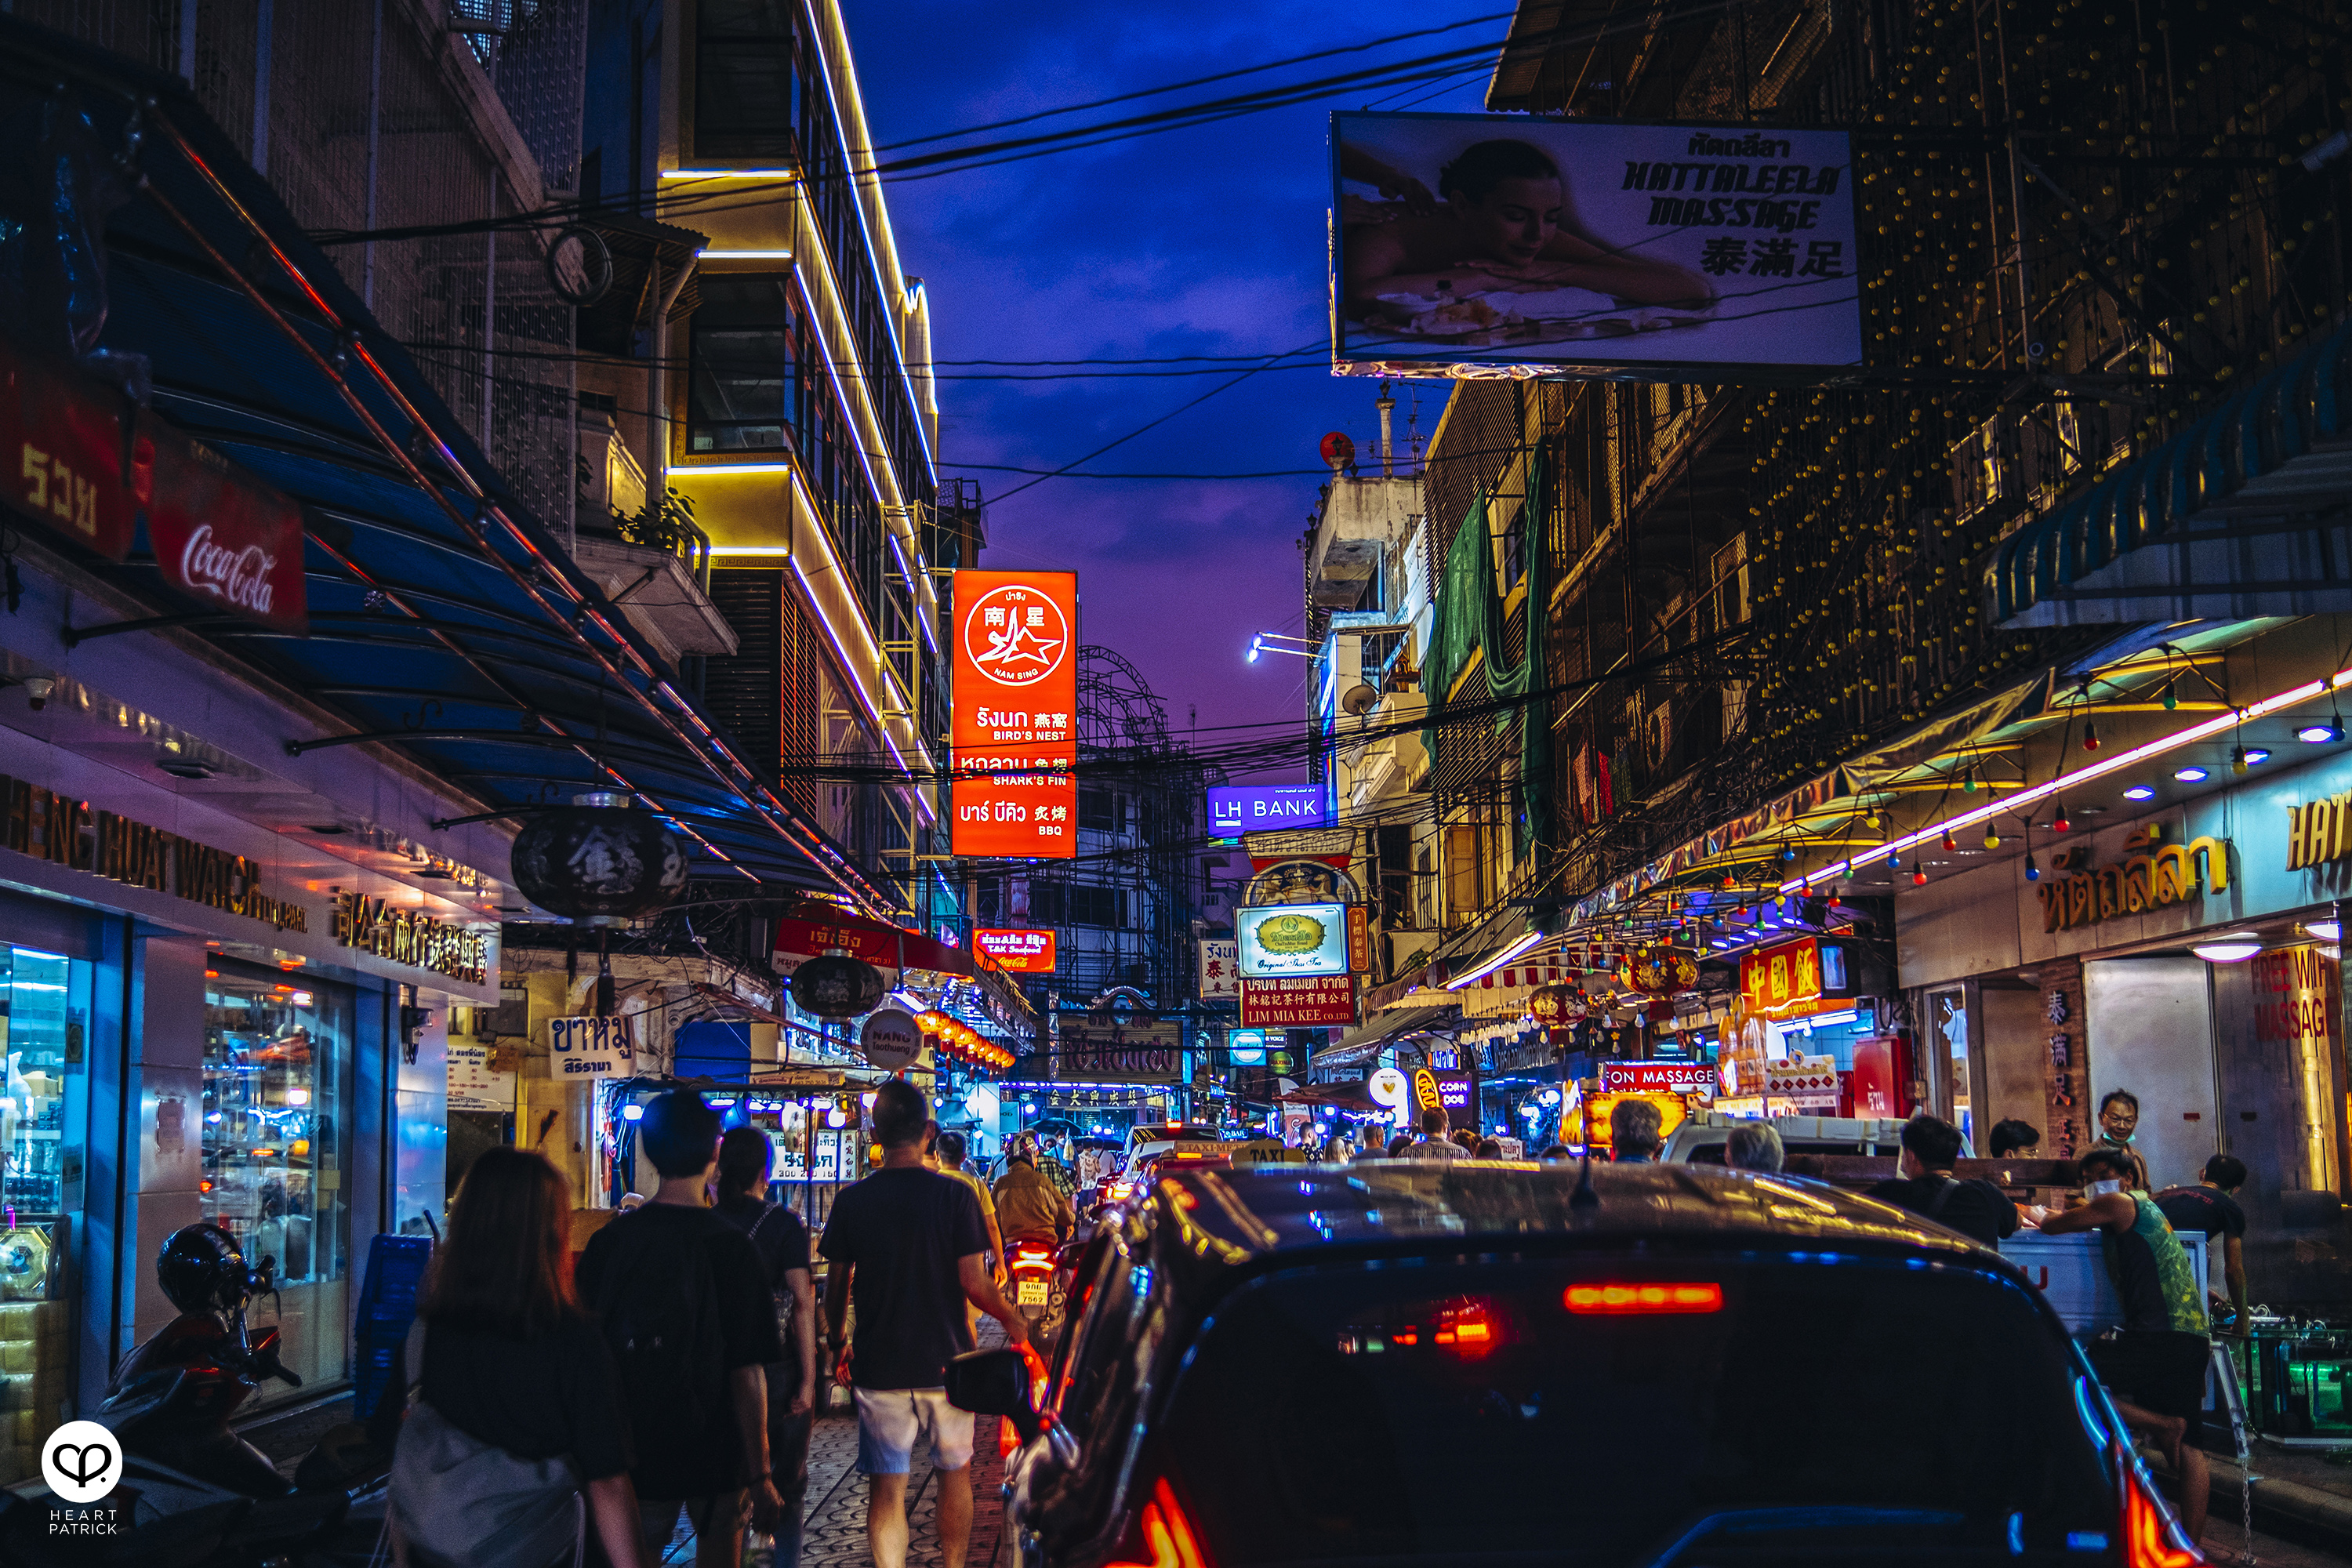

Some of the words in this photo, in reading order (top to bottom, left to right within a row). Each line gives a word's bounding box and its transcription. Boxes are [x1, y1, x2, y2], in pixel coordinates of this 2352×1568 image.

[1688, 132, 1790, 157] หัตถลีลา
[1621, 162, 1840, 194] HATTALEELA
[1647, 197, 1820, 233] MASSAGE
[1700, 237, 1843, 278] 泰滿足
[994, 668, 1014, 680] NAM
[1017, 668, 1039, 680] SING
[977, 706, 1028, 728] รังนก
[993, 731, 1033, 741] BIRD'S
[1036, 731, 1066, 741] NEST
[993, 775, 1044, 786] SHARK'S
[1048, 775, 1066, 786] FIN
[960, 800, 990, 822] บาร์
[994, 800, 1026, 822] บีคิว
[1215, 801, 1241, 817] LH
[1254, 799, 1317, 816] BANK
[1038, 826, 1062, 836] BBQ
[95, 810, 176, 892] HUAT
[176, 835, 260, 916] WATCH
[2038, 822, 2228, 933] หัตถลีลา
[1257, 960, 1287, 971] Original
[1287, 958, 1305, 967] Thai
[1306, 957, 1322, 966] Tea
[1249, 1011, 1269, 1022] LIM
[1273, 1010, 1295, 1022] MIA
[1298, 1009, 1322, 1021] KEE
[552, 1016, 632, 1059] ขาหมู
[1643, 1070, 1714, 1083] MASSAGE
[1439, 1082, 1468, 1093] CORN
[1443, 1094, 1465, 1105] DOG
[1250, 1149, 1286, 1162] TAXI
